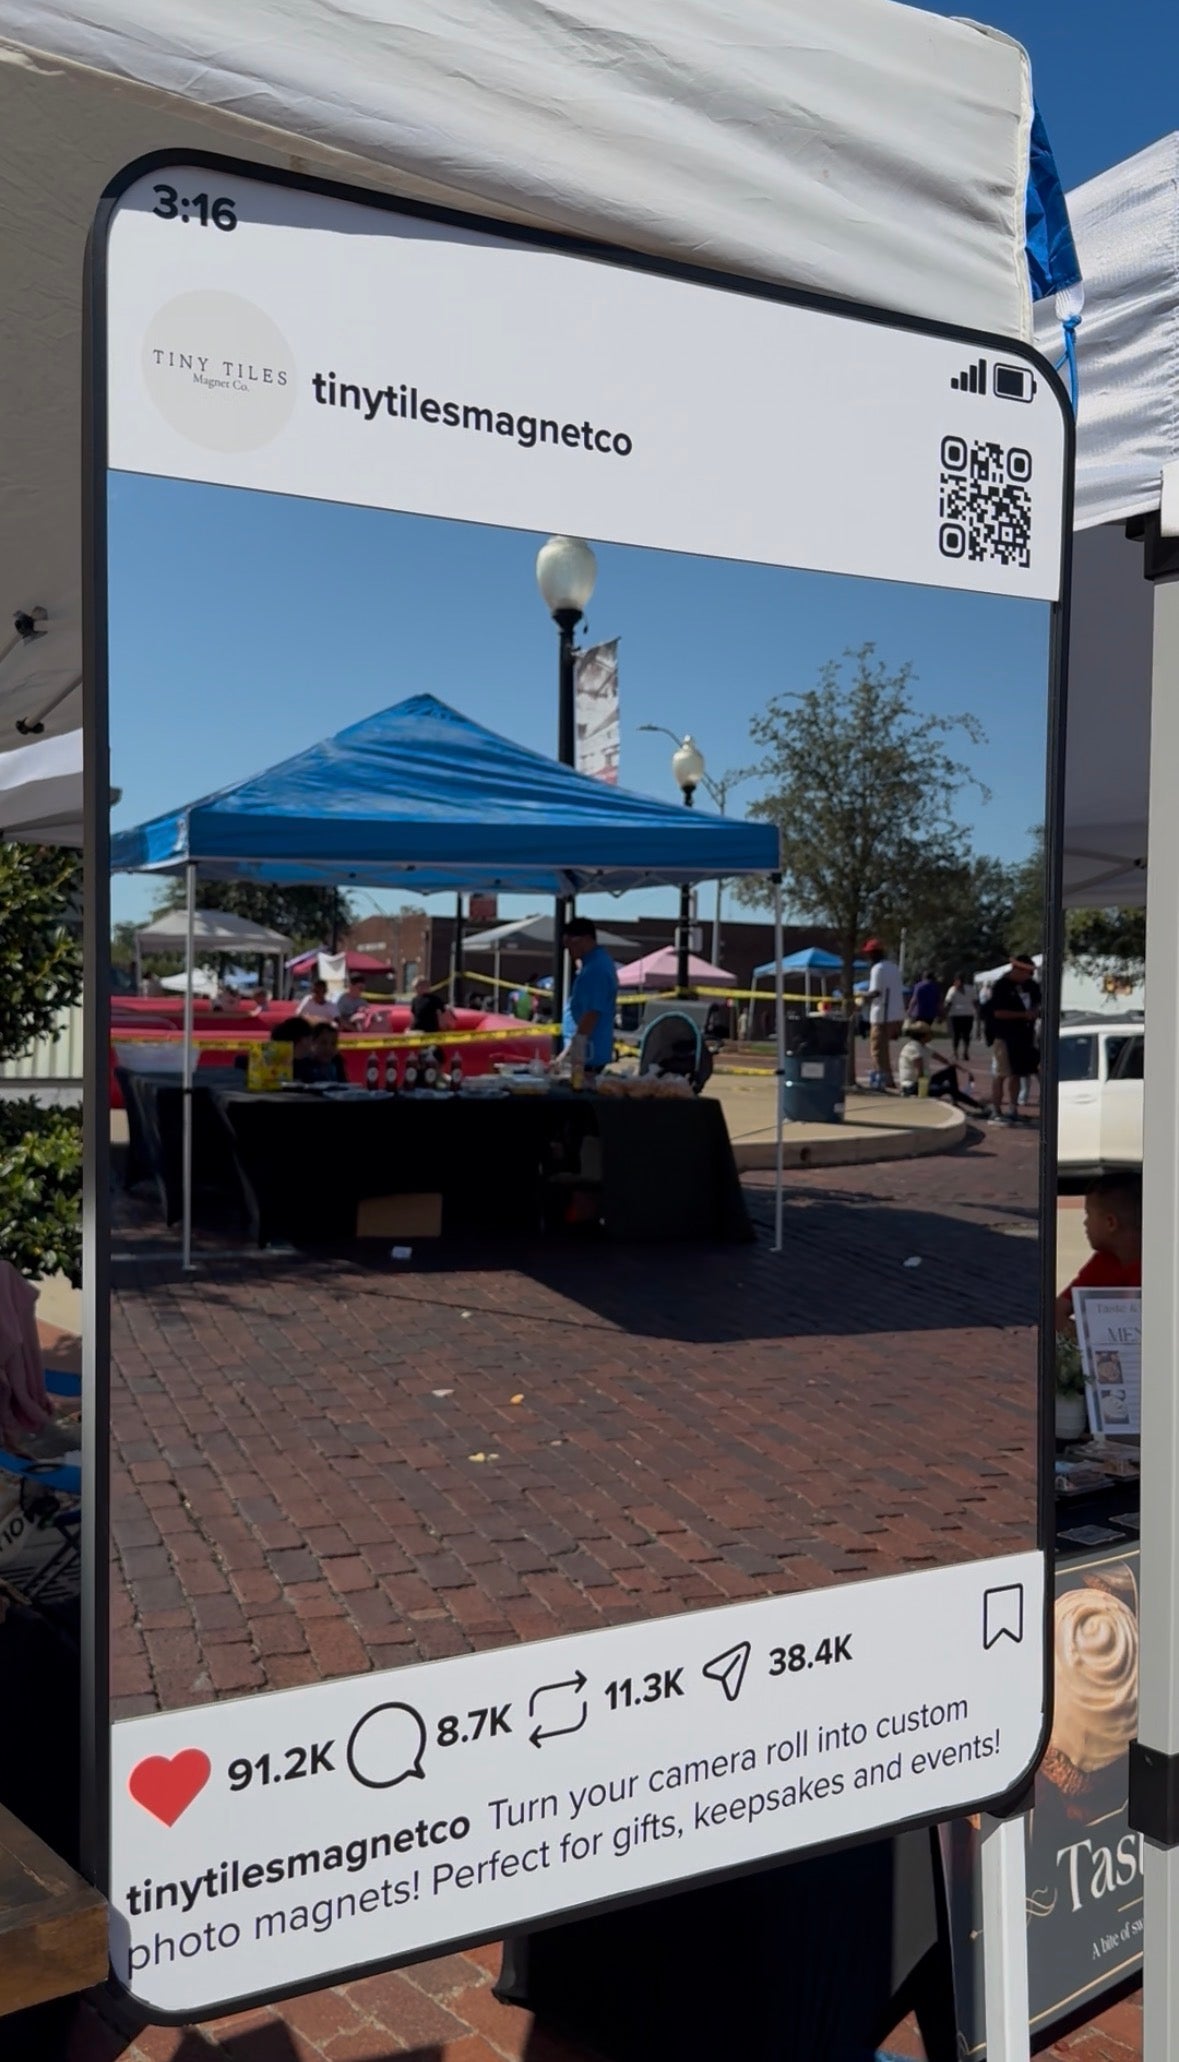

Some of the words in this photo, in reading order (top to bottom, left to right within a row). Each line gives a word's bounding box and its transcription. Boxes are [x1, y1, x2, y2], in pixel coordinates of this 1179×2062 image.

[151, 183, 238, 232] 3:16
[152, 348, 209, 373] TINY
[222, 360, 288, 387] TILES
[192, 372, 230, 390] Magnet
[232, 379, 250, 392] Co.
[311, 371, 634, 457] tinytilesmagnetco
[227, 1739, 337, 1792] 91.2K
[436, 1703, 513, 1748] 8.7K
[604, 1667, 685, 1711] 11.3K
[768, 1633, 854, 1677] 38.4K
[125, 1816, 471, 1916] tinytilesmagnetco
[487, 1794, 558, 1831] Turn
[569, 1775, 639, 1820] your
[648, 1748, 757, 1794] camera
[767, 1729, 809, 1766] roll
[818, 1722, 868, 1754] into
[876, 1699, 969, 1739] custom
[127, 1922, 241, 1980] photo
[255, 1870, 420, 1941] magnets!
[433, 1841, 551, 1896] Perfect
[559, 1832, 604, 1864] for
[613, 1812, 684, 1857] gifts,
[694, 1774, 846, 1830] keepsakes
[853, 1752, 903, 1790] and
[911, 1728, 1001, 1775] events!
[1100, 1933, 1119, 1953] bite
[1120, 1921, 1131, 1941] of
